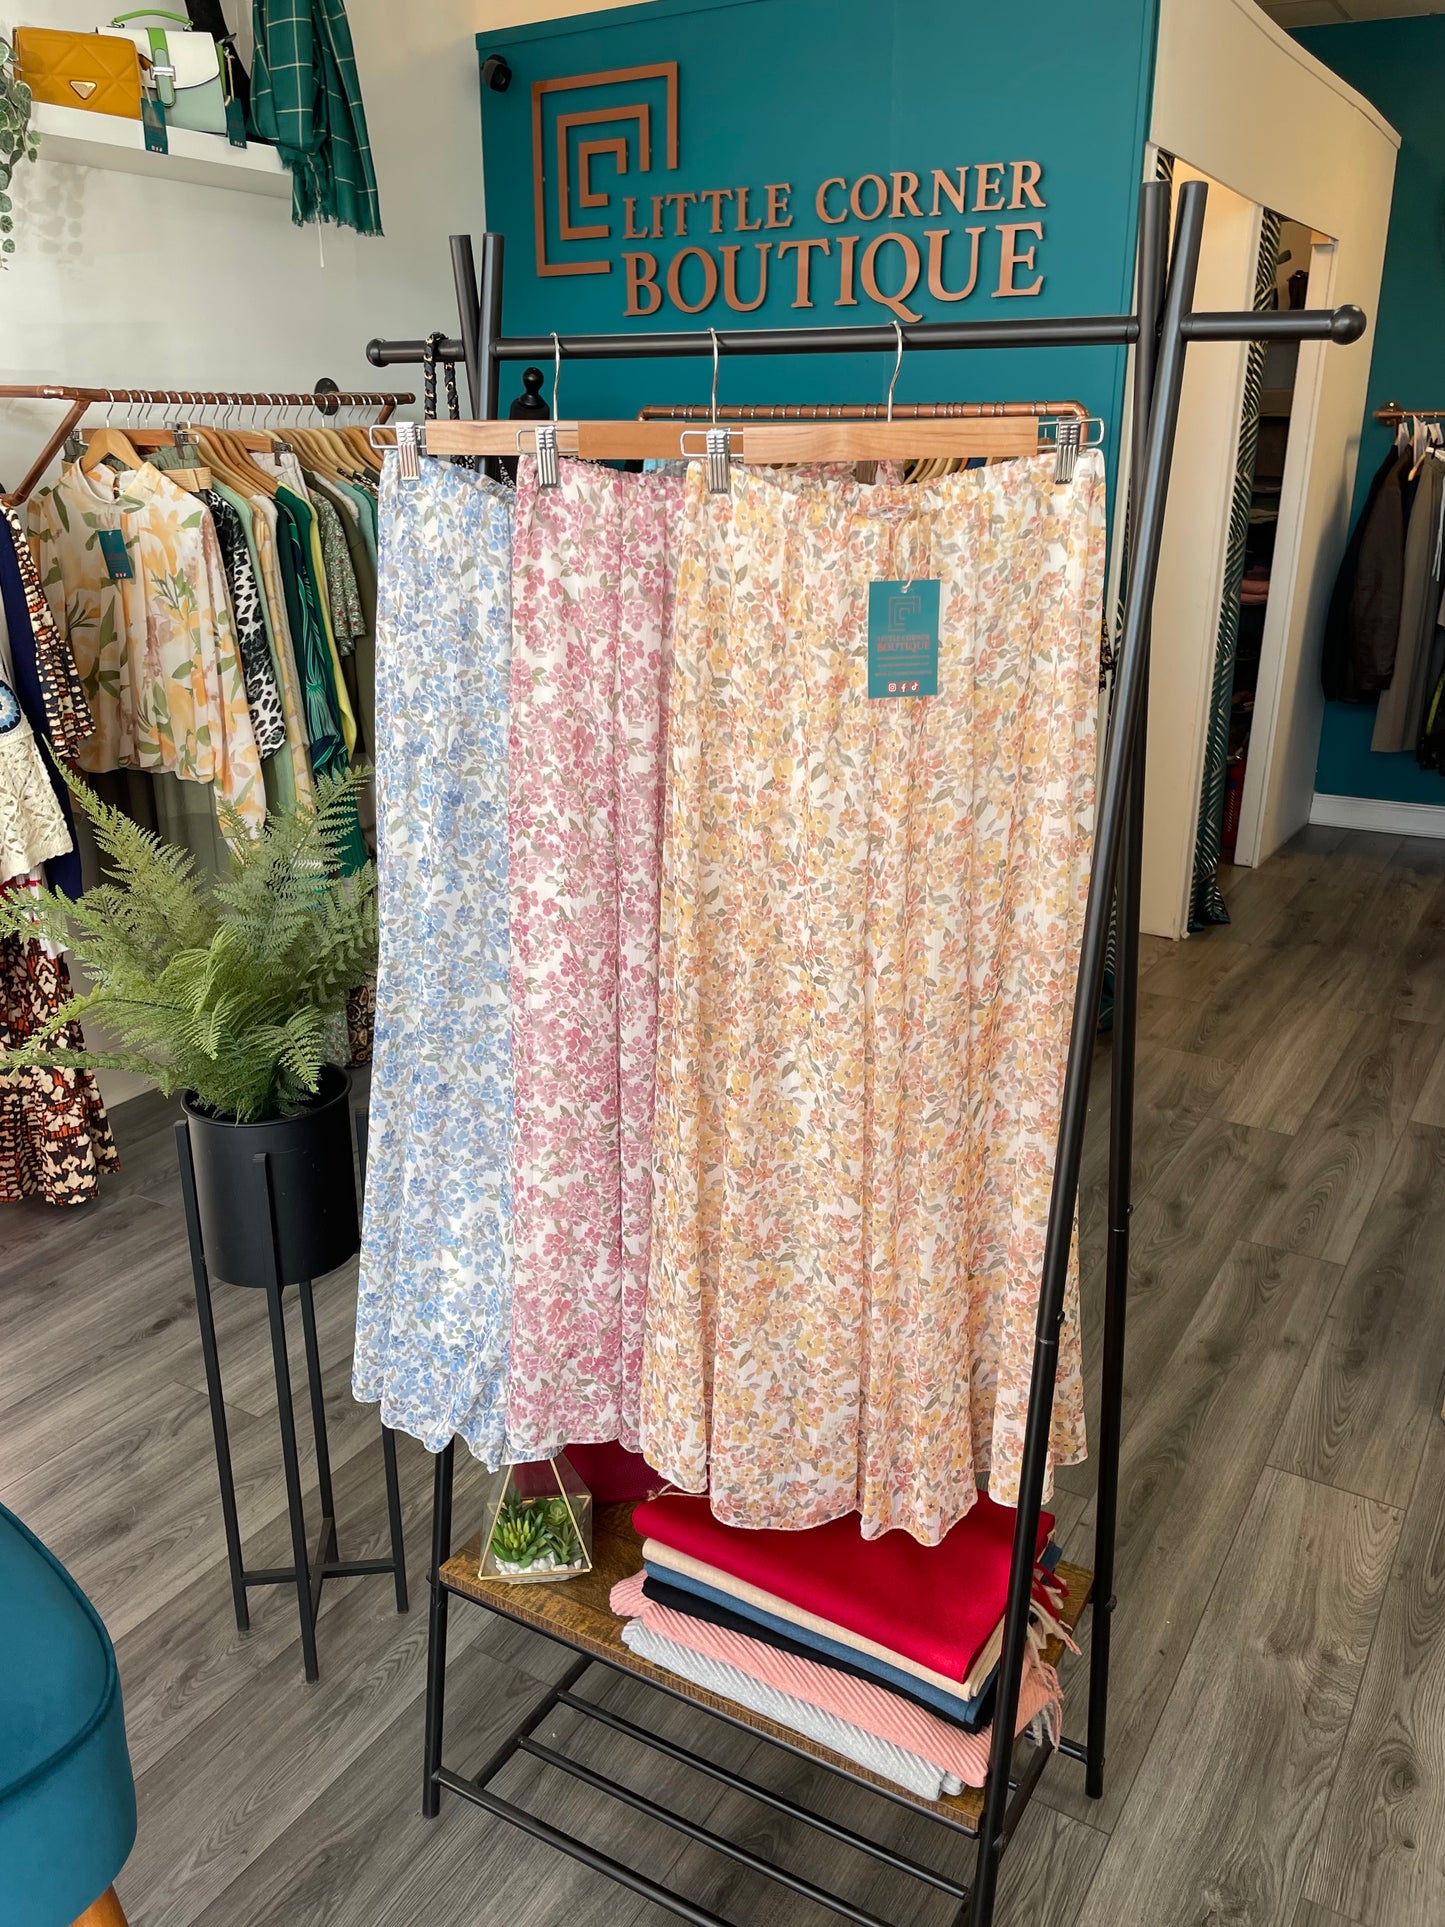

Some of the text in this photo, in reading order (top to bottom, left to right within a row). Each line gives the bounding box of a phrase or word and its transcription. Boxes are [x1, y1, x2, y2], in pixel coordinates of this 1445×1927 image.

[623, 160, 1046, 239] LITTLE CORNER
[622, 221, 1045, 323] BOUTIQUE
